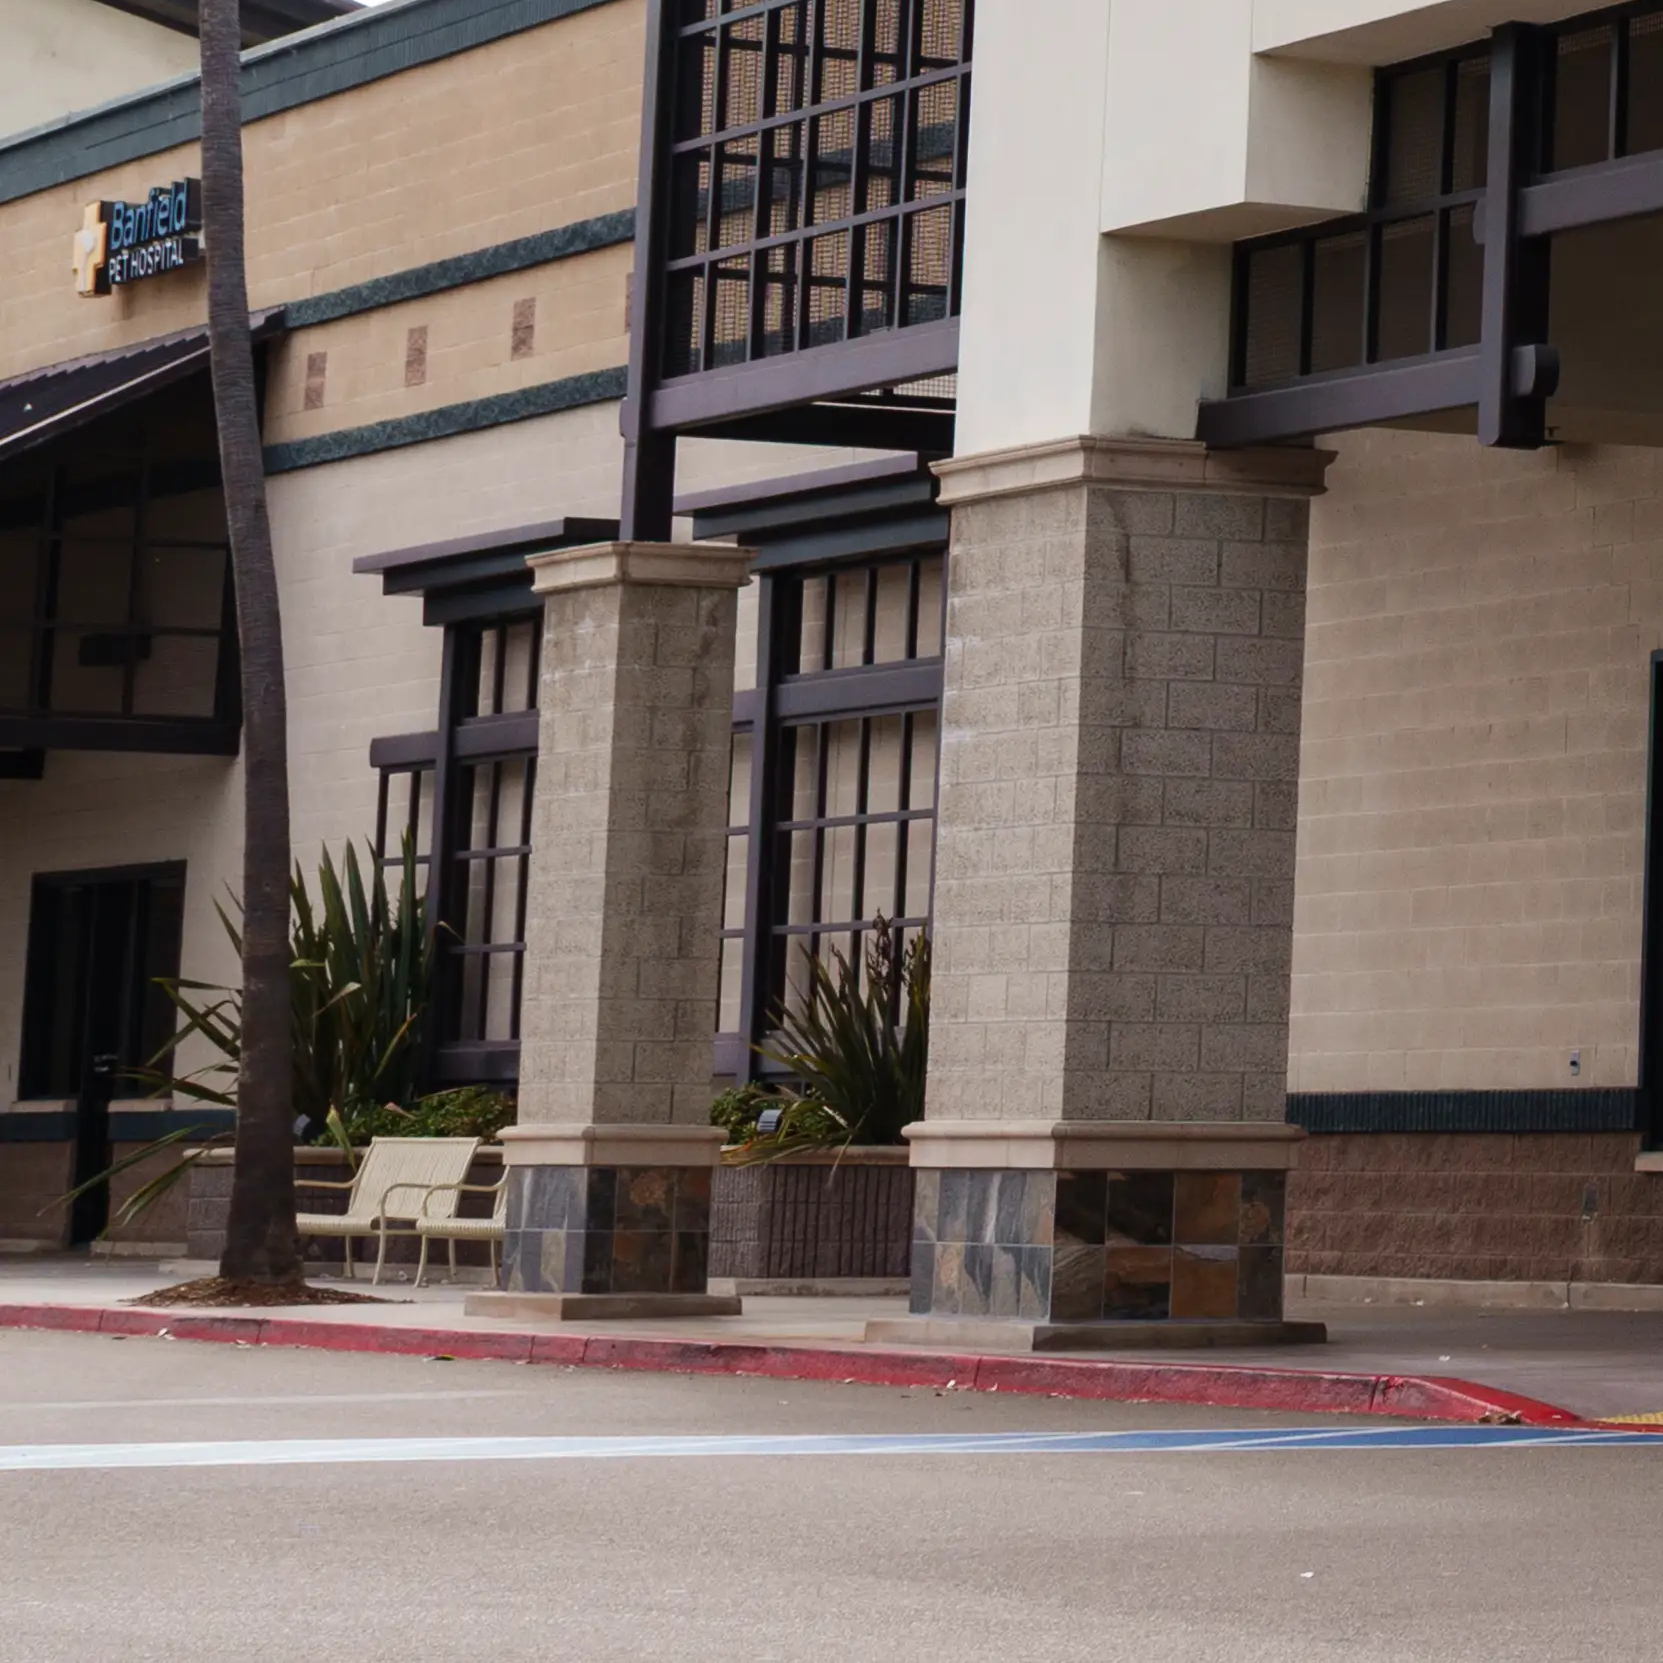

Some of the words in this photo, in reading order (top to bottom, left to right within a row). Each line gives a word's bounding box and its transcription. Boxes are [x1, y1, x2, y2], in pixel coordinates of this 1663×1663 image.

[109, 177, 189, 250] Banfield
[108, 252, 129, 284] PET
[130, 239, 185, 279] HOSPITAL
